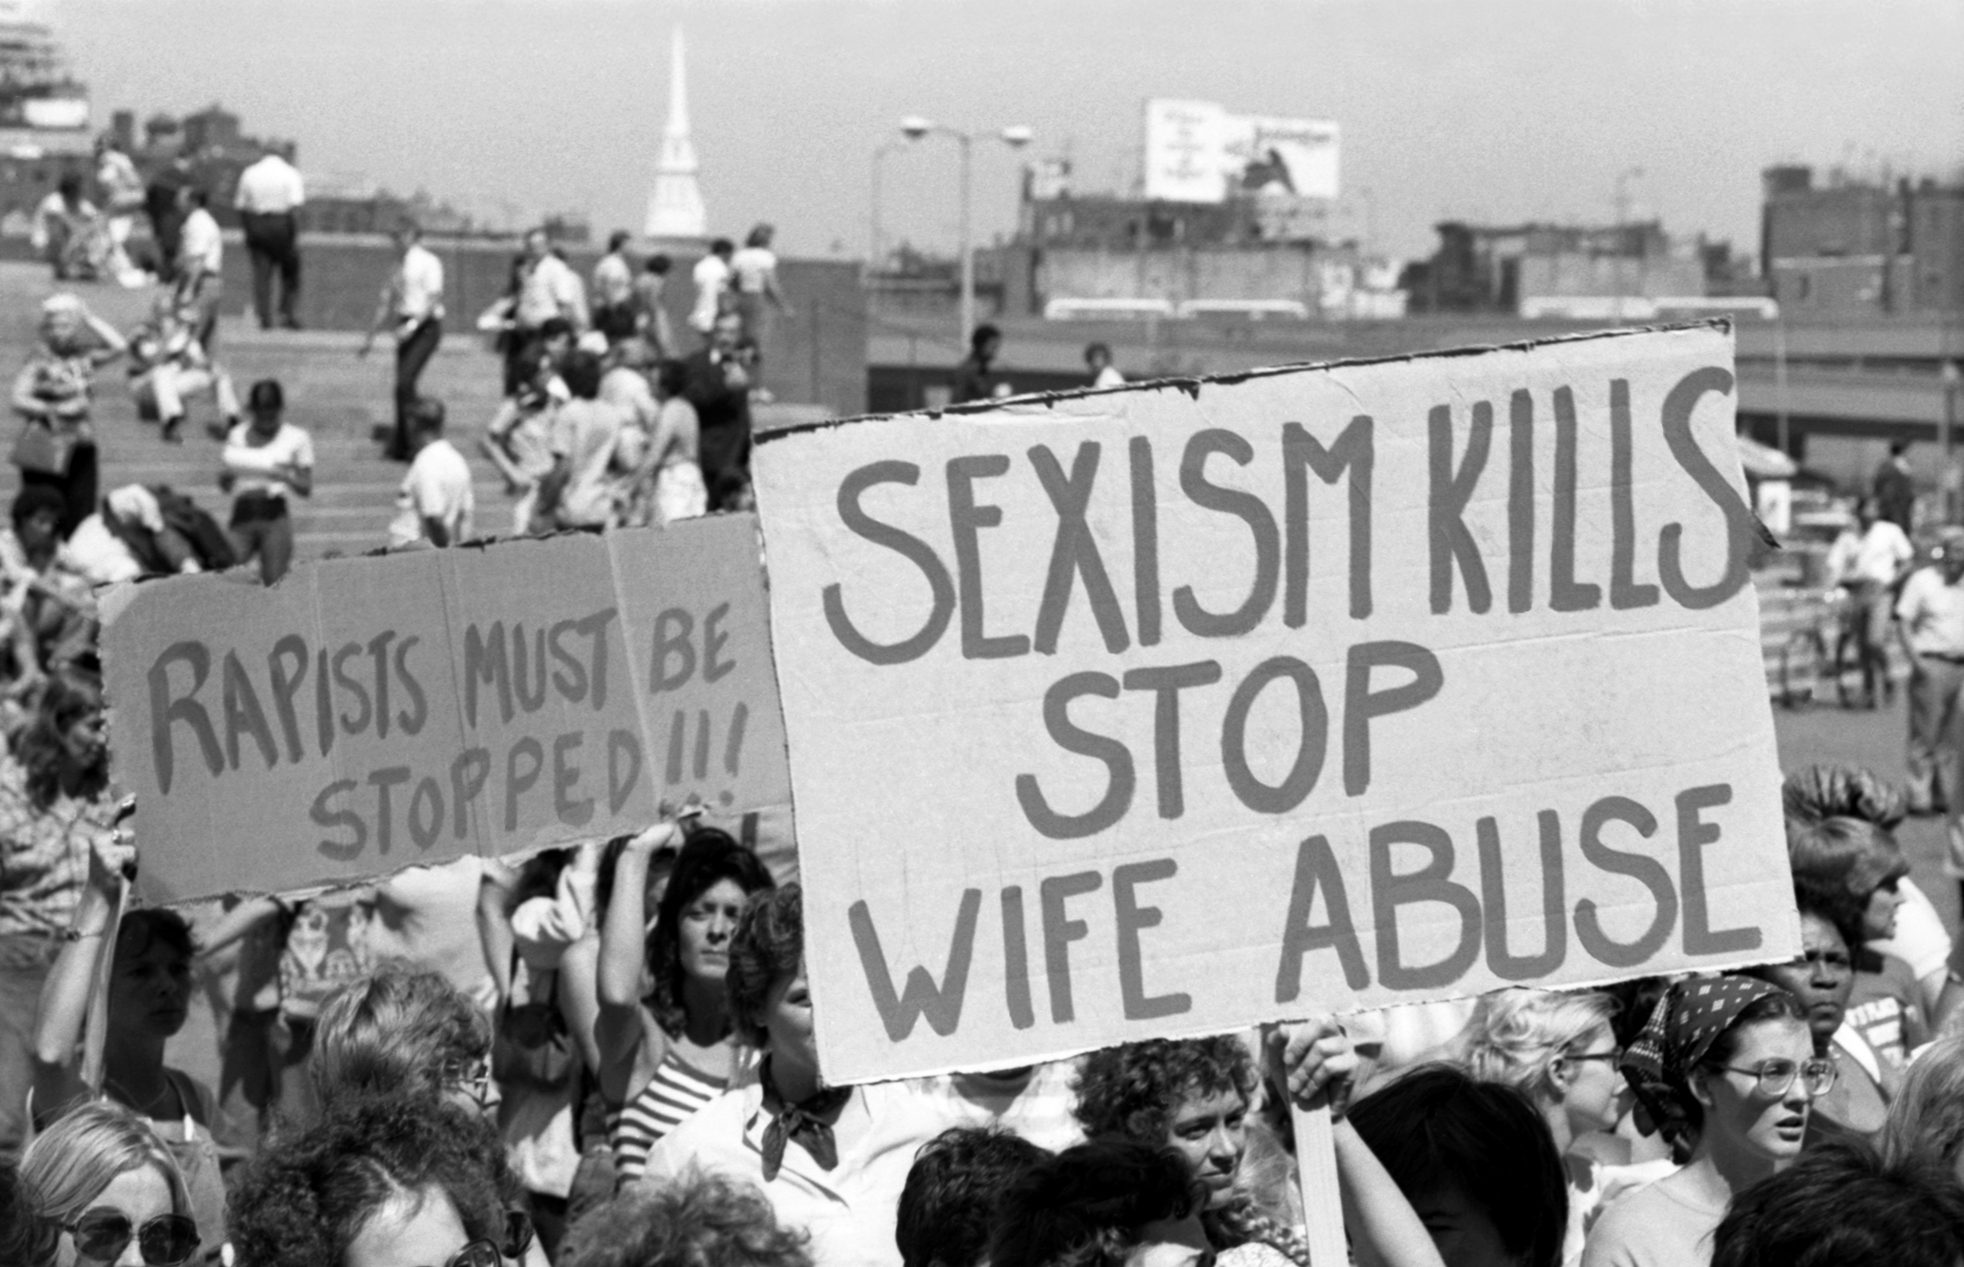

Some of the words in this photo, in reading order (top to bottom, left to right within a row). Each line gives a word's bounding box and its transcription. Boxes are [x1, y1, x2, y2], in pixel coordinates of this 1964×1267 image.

[823, 415, 1374, 665] SEXISM
[1428, 366, 1752, 615] KILLS
[148, 634, 427, 796] RAPISTS
[465, 606, 618, 729] MUST
[650, 601, 737, 694] BE
[1016, 640, 1444, 839] STOP
[848, 858, 1192, 1042] WIFE
[1276, 783, 1762, 1004] ABUSE
